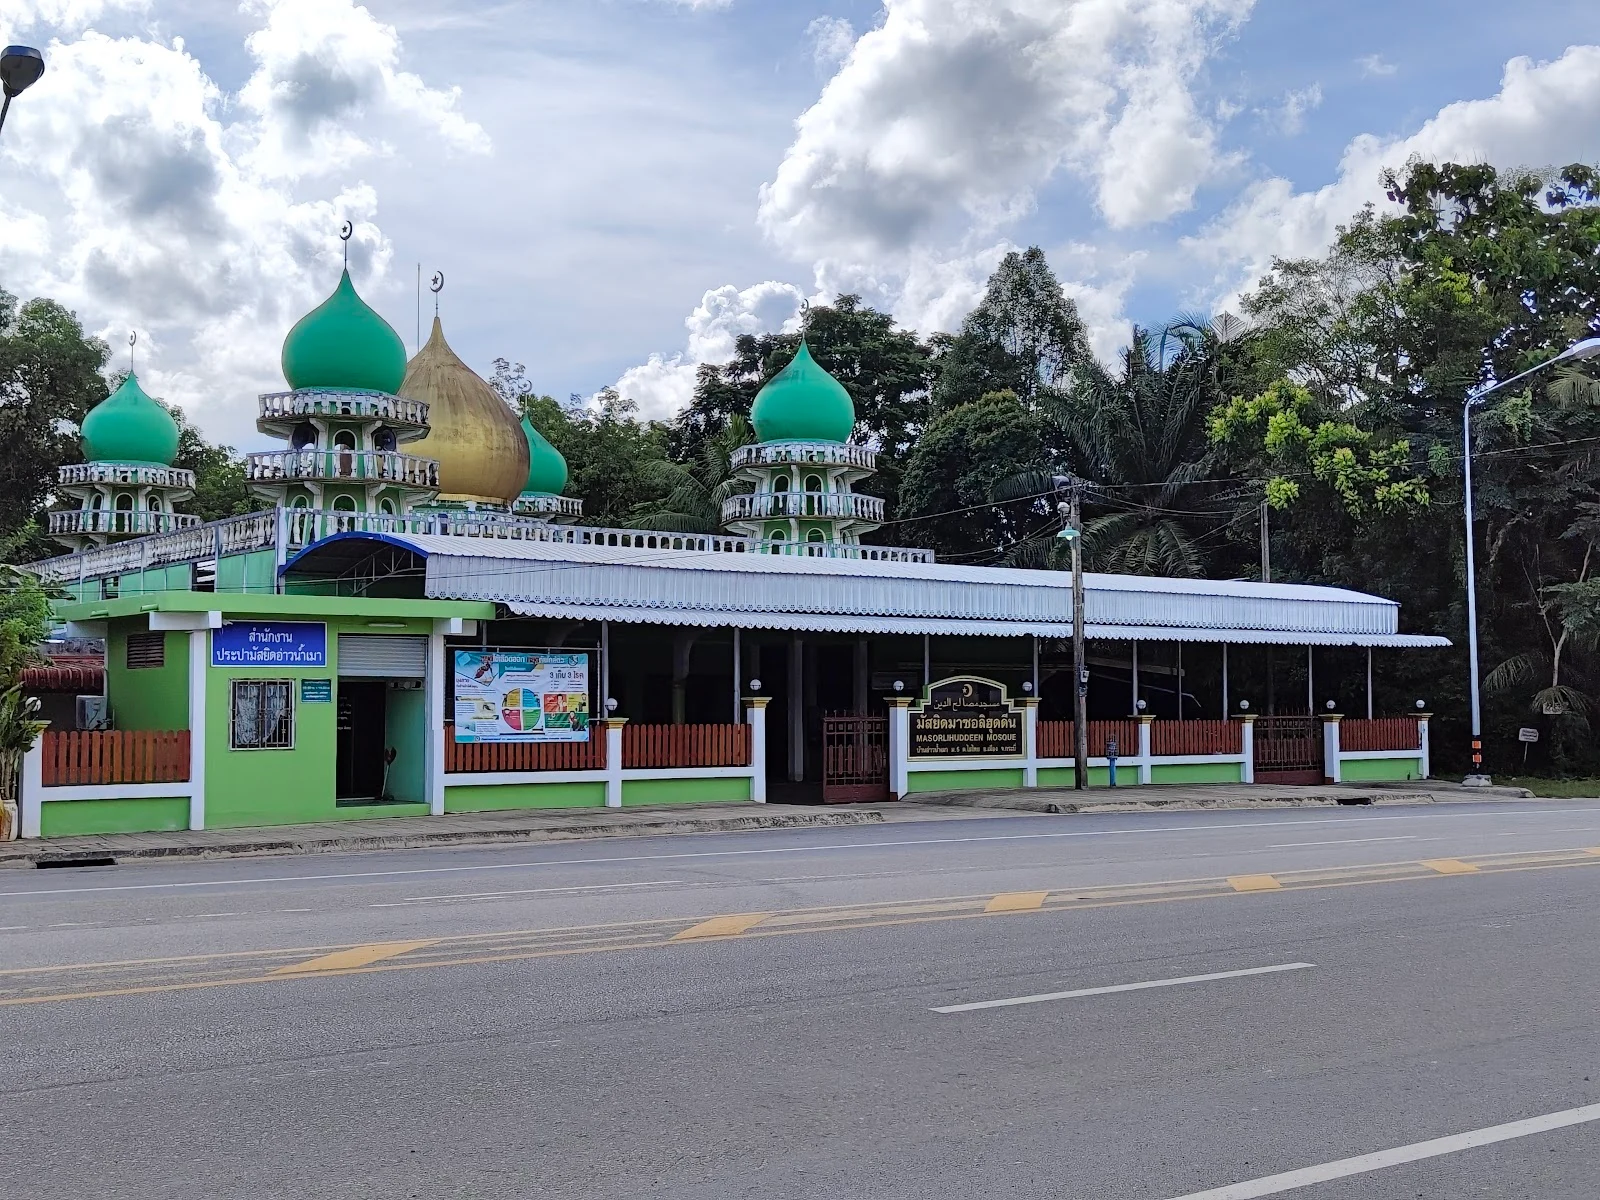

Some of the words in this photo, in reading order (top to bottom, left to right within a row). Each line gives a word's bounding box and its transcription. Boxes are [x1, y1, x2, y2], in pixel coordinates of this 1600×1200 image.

[248, 627, 293, 643] สำนักงาน
[216, 644, 322, 661] ประปามัสยิดอ่าวน้ำเมา
[549, 671, 554, 679] 3
[555, 669, 567, 679] เก็บ
[567, 671, 572, 679] 3
[573, 670, 584, 680] โรค
[916, 713, 1017, 733] มัสยิดมาซอลิฮุดดีน
[916, 733, 984, 743] MASORLIHUDDEEN
[986, 733, 1017, 742] MOSQUE
